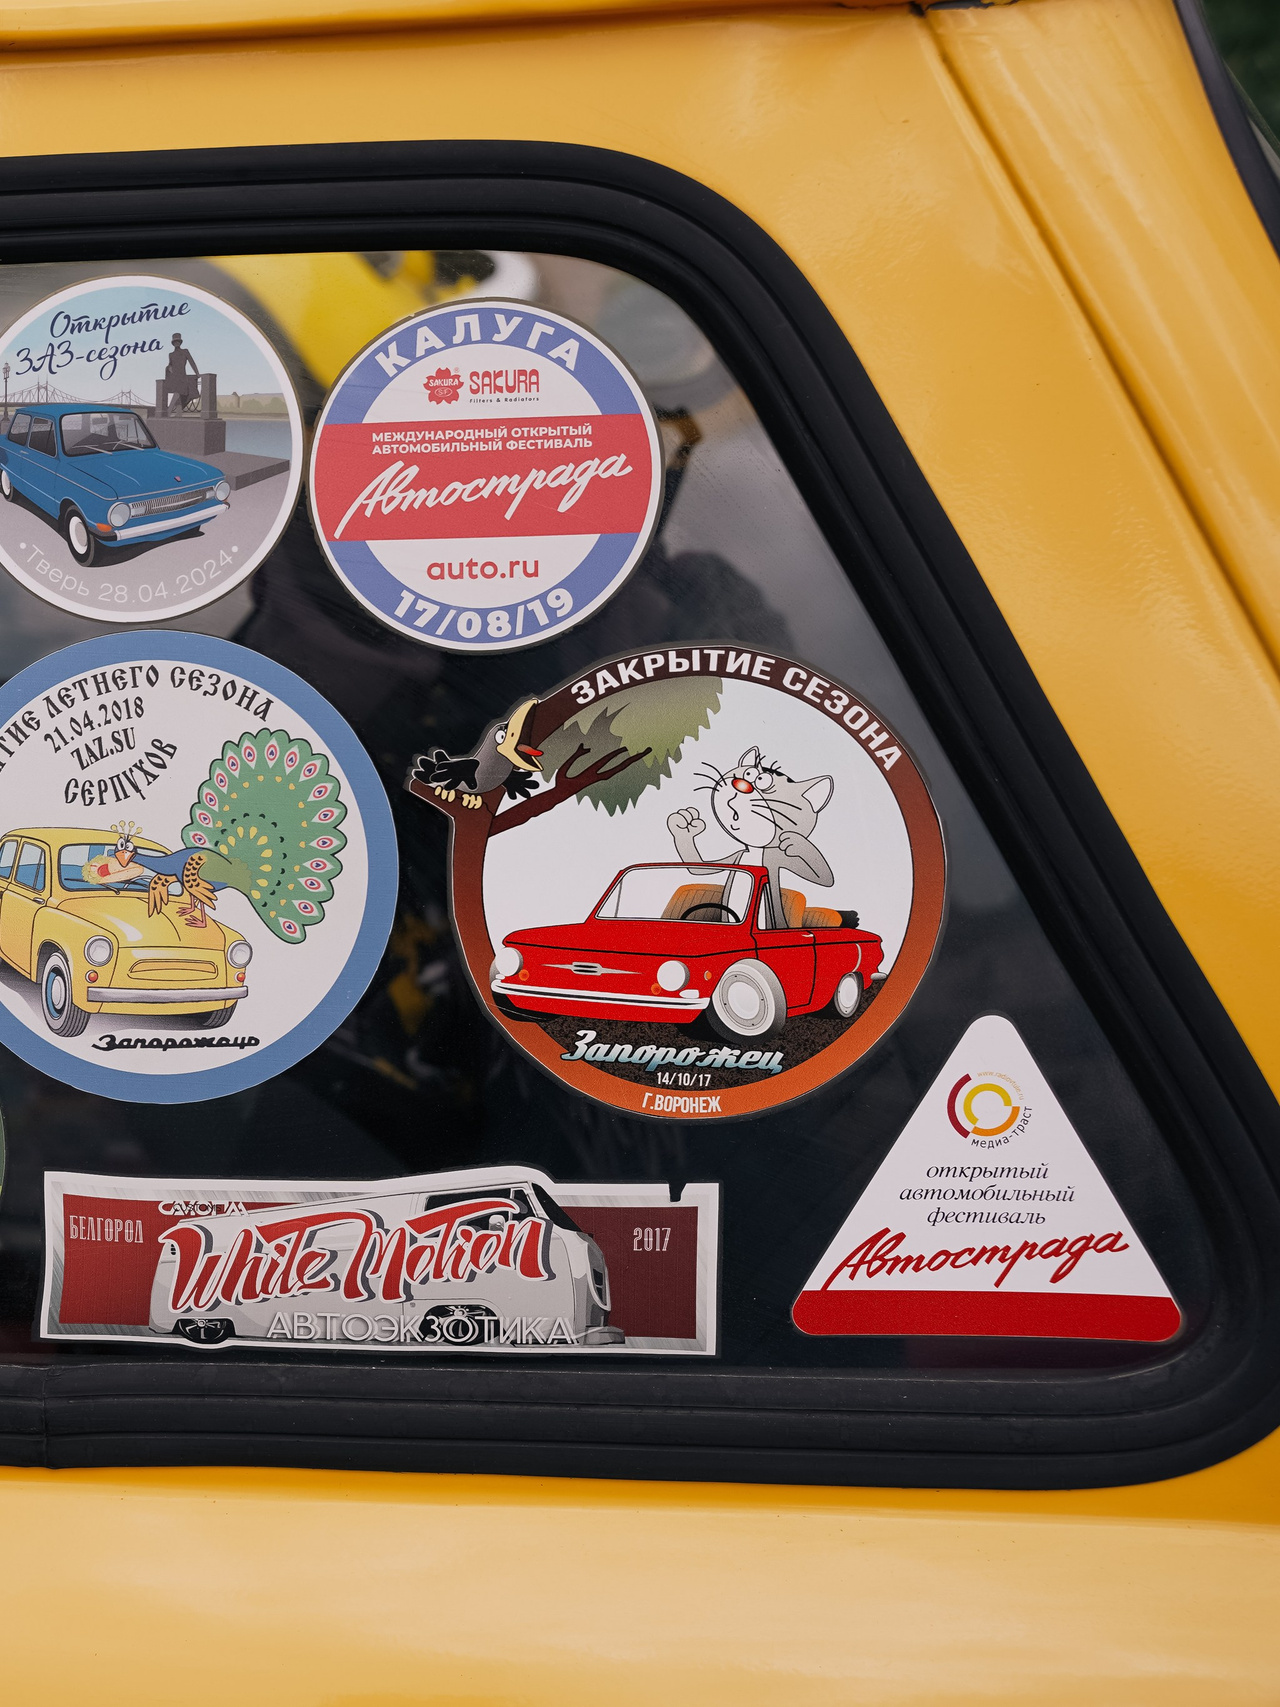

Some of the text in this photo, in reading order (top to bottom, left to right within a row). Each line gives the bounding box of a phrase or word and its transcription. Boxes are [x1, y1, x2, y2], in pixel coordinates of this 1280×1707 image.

[49, 301, 191, 343] Открытие
[15, 336, 164, 381] ЗАЗ-сезона
[374, 314, 580, 378] КАЛУГА
[429, 378, 459, 387] SAKURA
[469, 369, 539, 395] SAKURA
[372, 423, 592, 442] МЕЖДУНАРОДНЫЙ ОТКРЫТЫЙ
[372, 438, 593, 455] АВТОМОБИЛЬНЫЙ ФЕСТИВАЛЬ
[334, 453, 633, 540] Автострада
[26, 544, 235, 603] Тверь 28.04.2024
[426, 557, 539, 580] auto.ru
[393, 588, 574, 638] 17/08/19
[42, 665, 160, 719] ЛЕТНЕГО
[170, 665, 275, 722] СЕЗОНА
[570, 649, 902, 771] ЗАКРЫТИЕ СЕЗОНА
[43, 696, 145, 754] 21.04.2018
[70, 726, 137, 771] ZAZ.SU
[64, 737, 179, 807] СЕРПУХОВ
[561, 1029, 784, 1075] Запорожец
[657, 1072, 712, 1087] 14/10/17
[642, 1092, 722, 1113] Г.ВОРОНЕЖ
[971, 1106, 1032, 1149] медиа-траст
[926, 1163, 1049, 1181] открытый
[899, 1185, 1076, 1203] автомобильный
[69, 1215, 143, 1244] БЕЛГОРОД
[926, 1206, 1045, 1227] фестиваль
[156, 1199, 550, 1313] White Motion
[633, 1227, 671, 1252] 2017
[820, 1226, 1130, 1291] Автострада
[266, 1313, 575, 1345] АВТОЭКЗОТИКА
